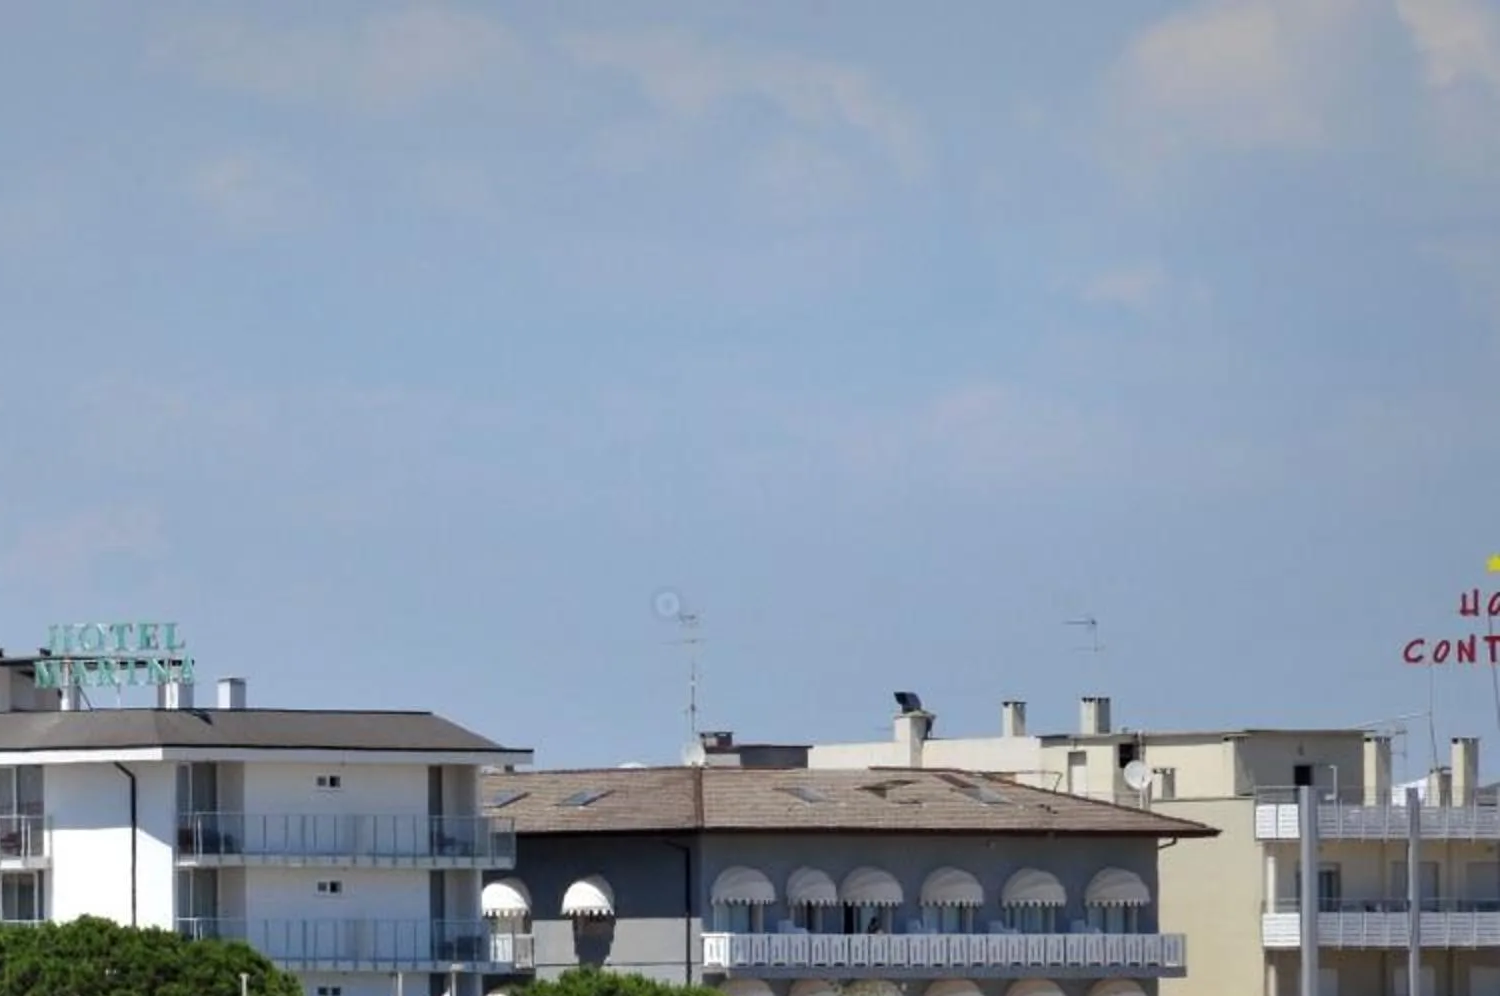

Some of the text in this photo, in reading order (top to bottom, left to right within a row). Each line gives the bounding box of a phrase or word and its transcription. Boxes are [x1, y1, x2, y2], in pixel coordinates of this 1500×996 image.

[48, 621, 186, 651] HOTEL
[1403, 633, 1500, 664] CONT
[34, 655, 197, 688] MARINA
